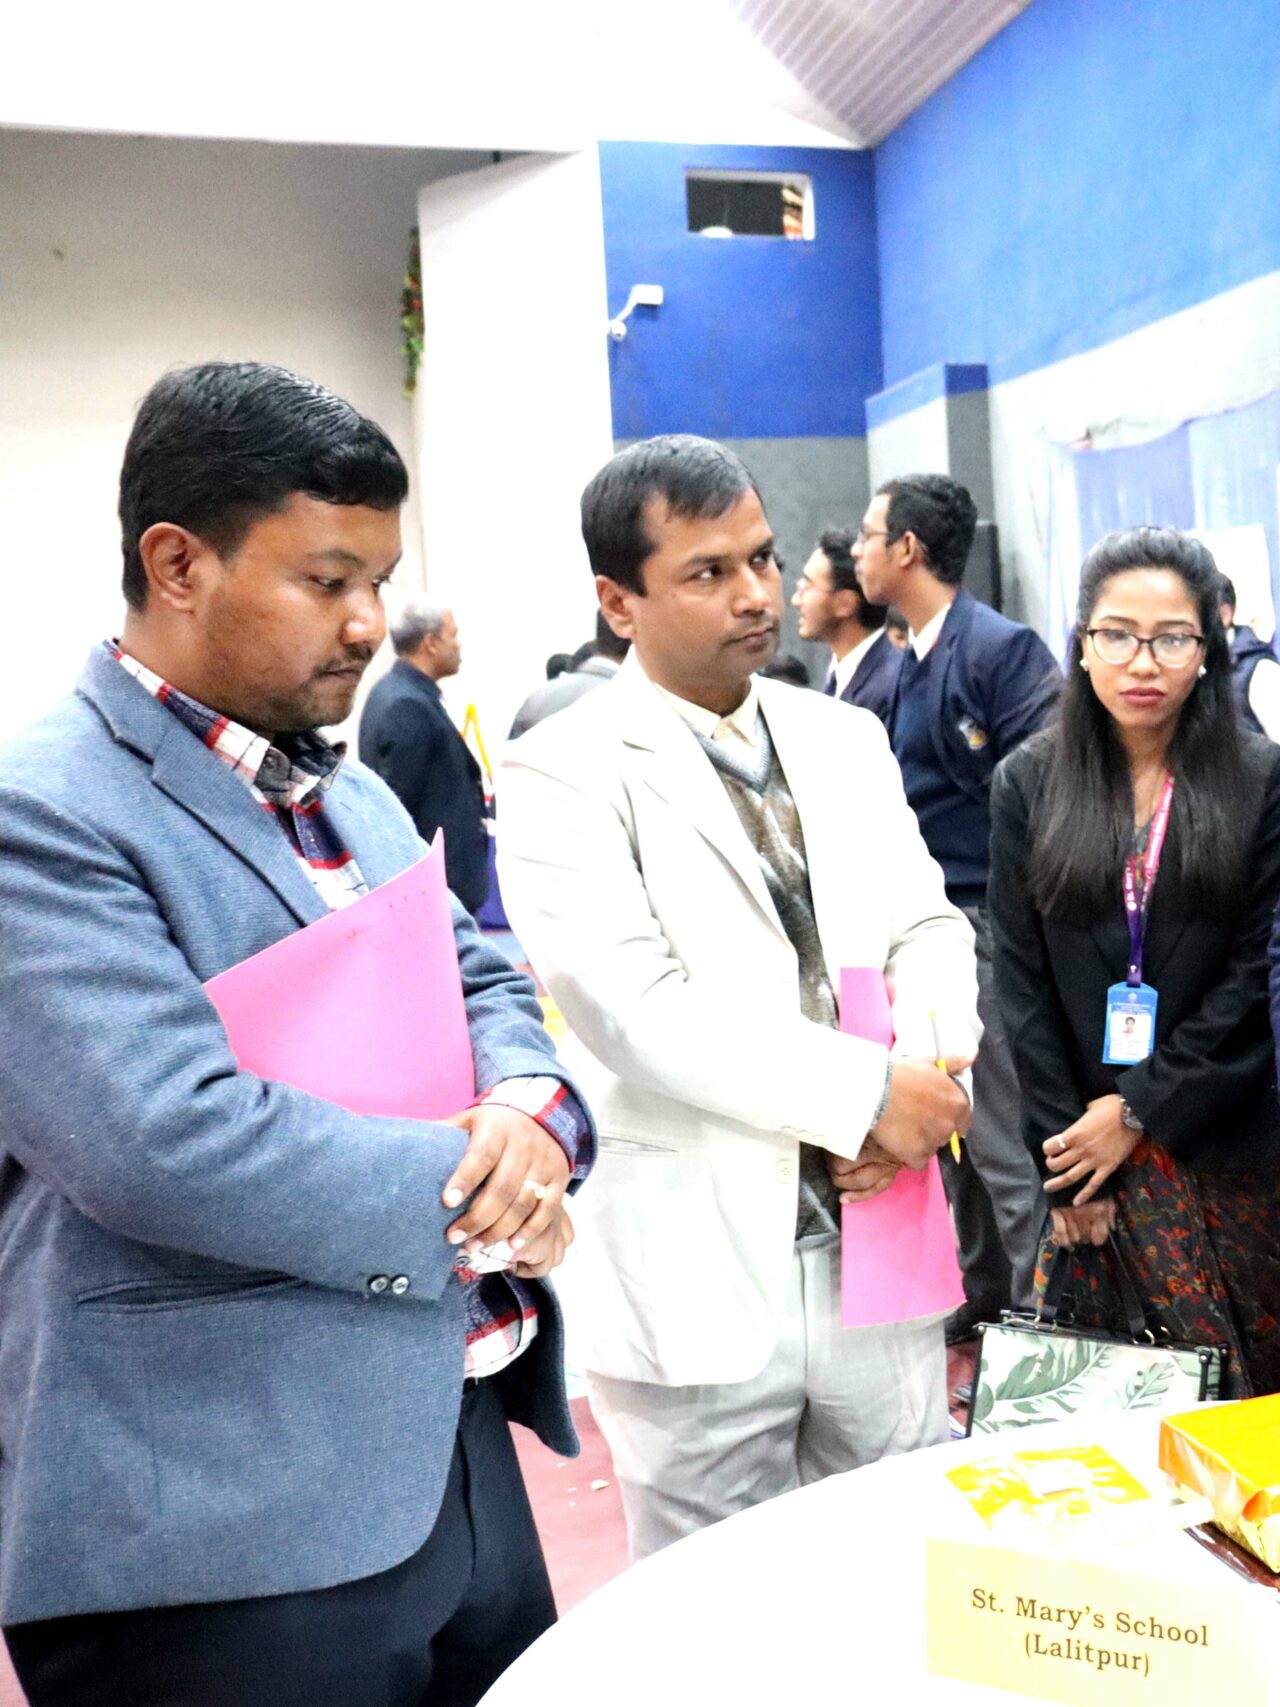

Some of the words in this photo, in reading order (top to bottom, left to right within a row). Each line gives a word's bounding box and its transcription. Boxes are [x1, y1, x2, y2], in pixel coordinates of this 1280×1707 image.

[972, 1588, 1004, 1613] St.
[1015, 1596, 1105, 1631] Mary's
[1115, 1611, 1208, 1646] School
[1025, 1632, 1149, 1677] (Lalitpur)
